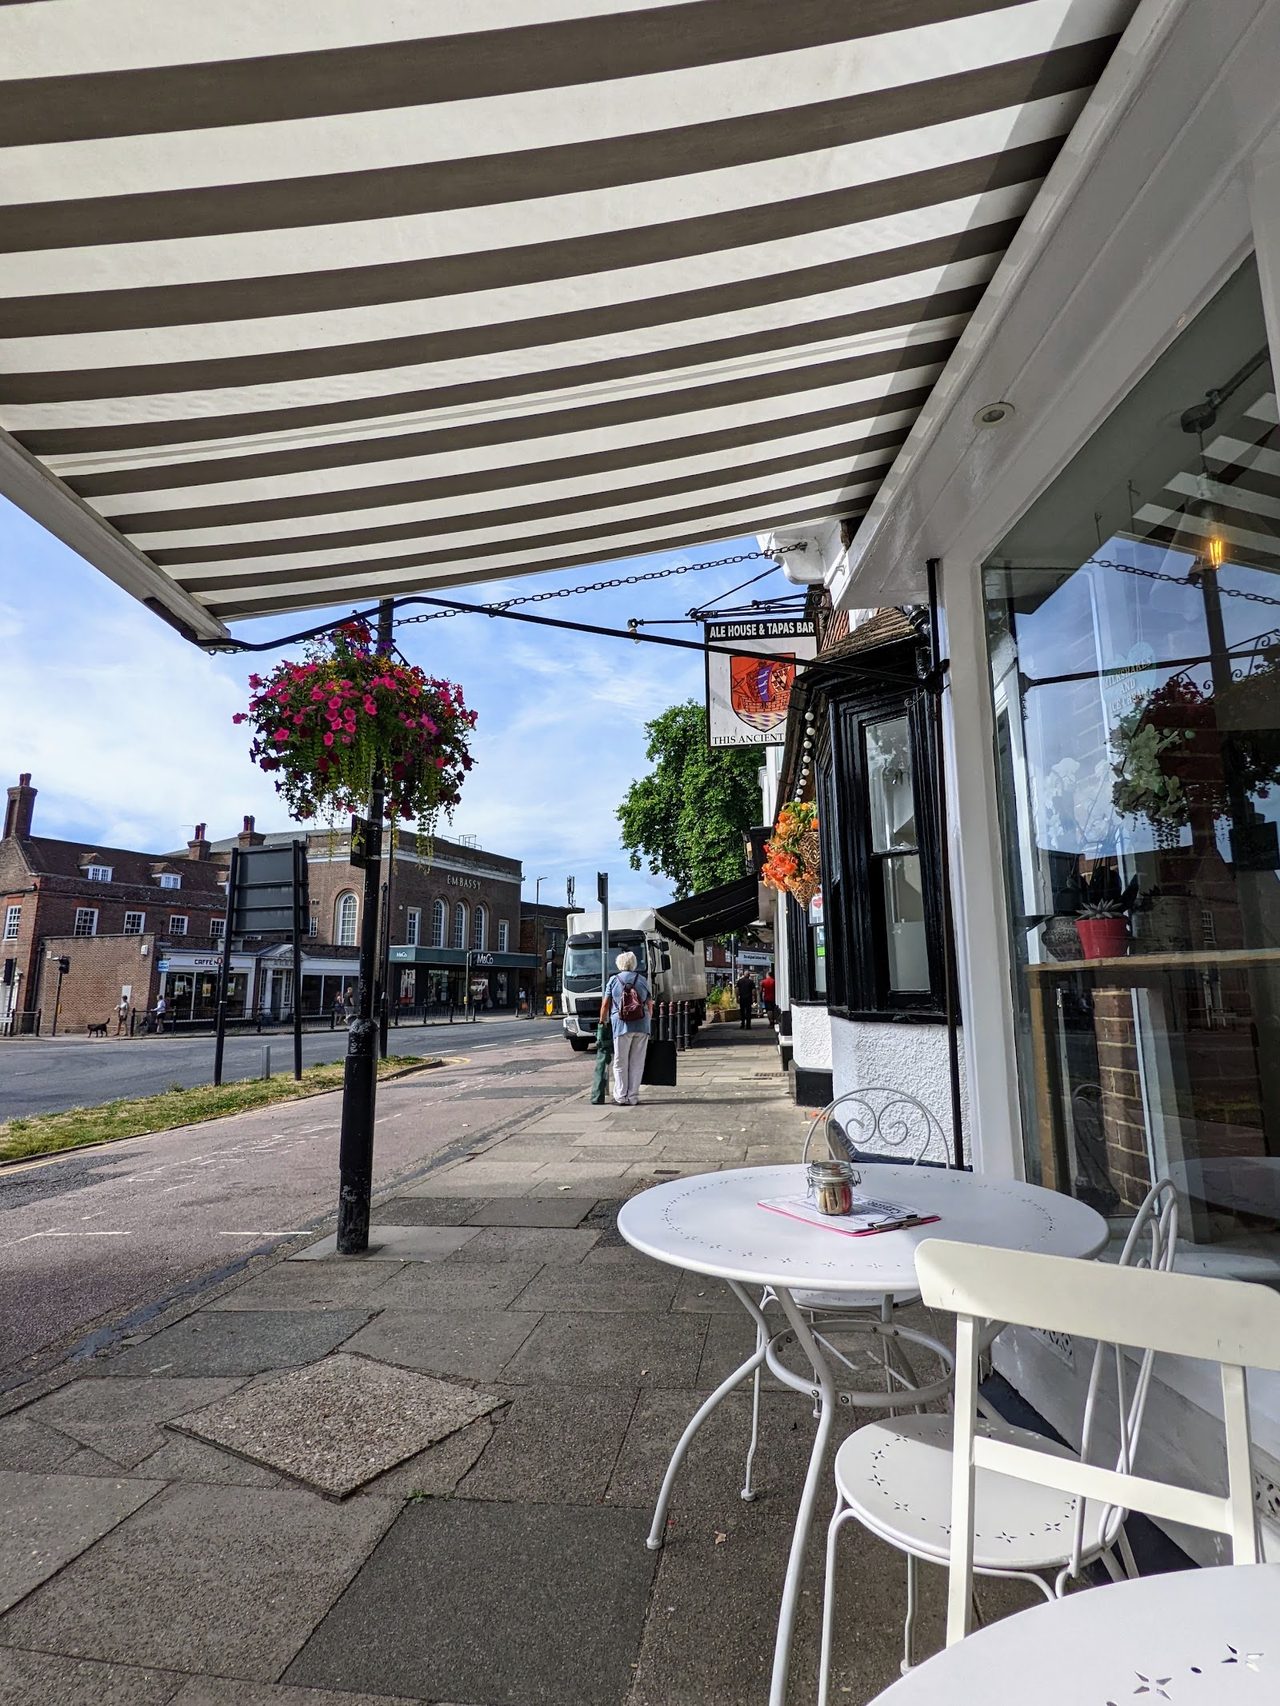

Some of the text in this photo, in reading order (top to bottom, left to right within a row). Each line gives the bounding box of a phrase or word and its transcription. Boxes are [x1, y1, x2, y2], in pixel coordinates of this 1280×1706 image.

[710, 621, 815, 638] ALE HOUSE & TAPAS BAR
[712, 733, 785, 745] THIS ANCIENT
[447, 874, 481, 890] EMBASSY
